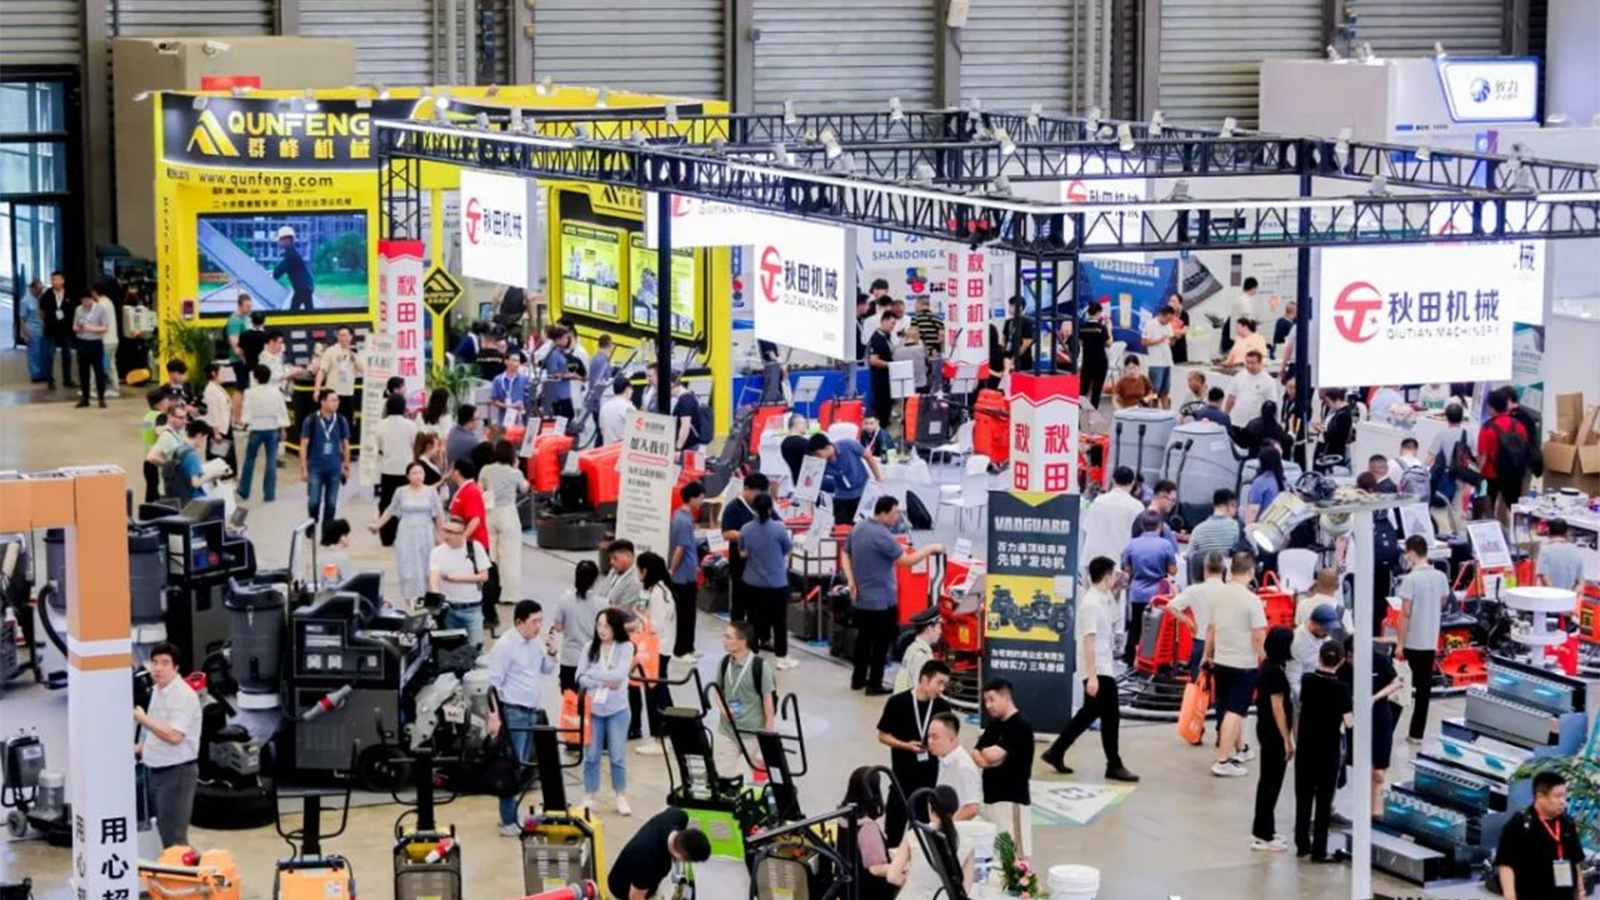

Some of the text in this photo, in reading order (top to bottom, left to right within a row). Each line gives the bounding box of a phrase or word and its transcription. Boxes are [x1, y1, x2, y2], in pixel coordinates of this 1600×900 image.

[228, 111, 370, 136] QUNFENG
[248, 137, 370, 159] 群峰机械
[199, 172, 333, 189] www.qunfeng.com
[483, 208, 522, 240] 秋田机械
[872, 250, 936, 261] SHANDONG
[784, 260, 839, 301] 秋田机械
[967, 253, 984, 348] 秋田机械
[1387, 288, 1500, 325] 秋田机械
[397, 275, 417, 377] 秋田机械
[1386, 325, 1500, 340] QIUTIAN MACHINERY
[630, 437, 669, 457] 加入我们
[1015, 423, 1030, 491] 秋田
[1044, 424, 1070, 493] 秋田
[994, 516, 1071, 535] VANGUARD
